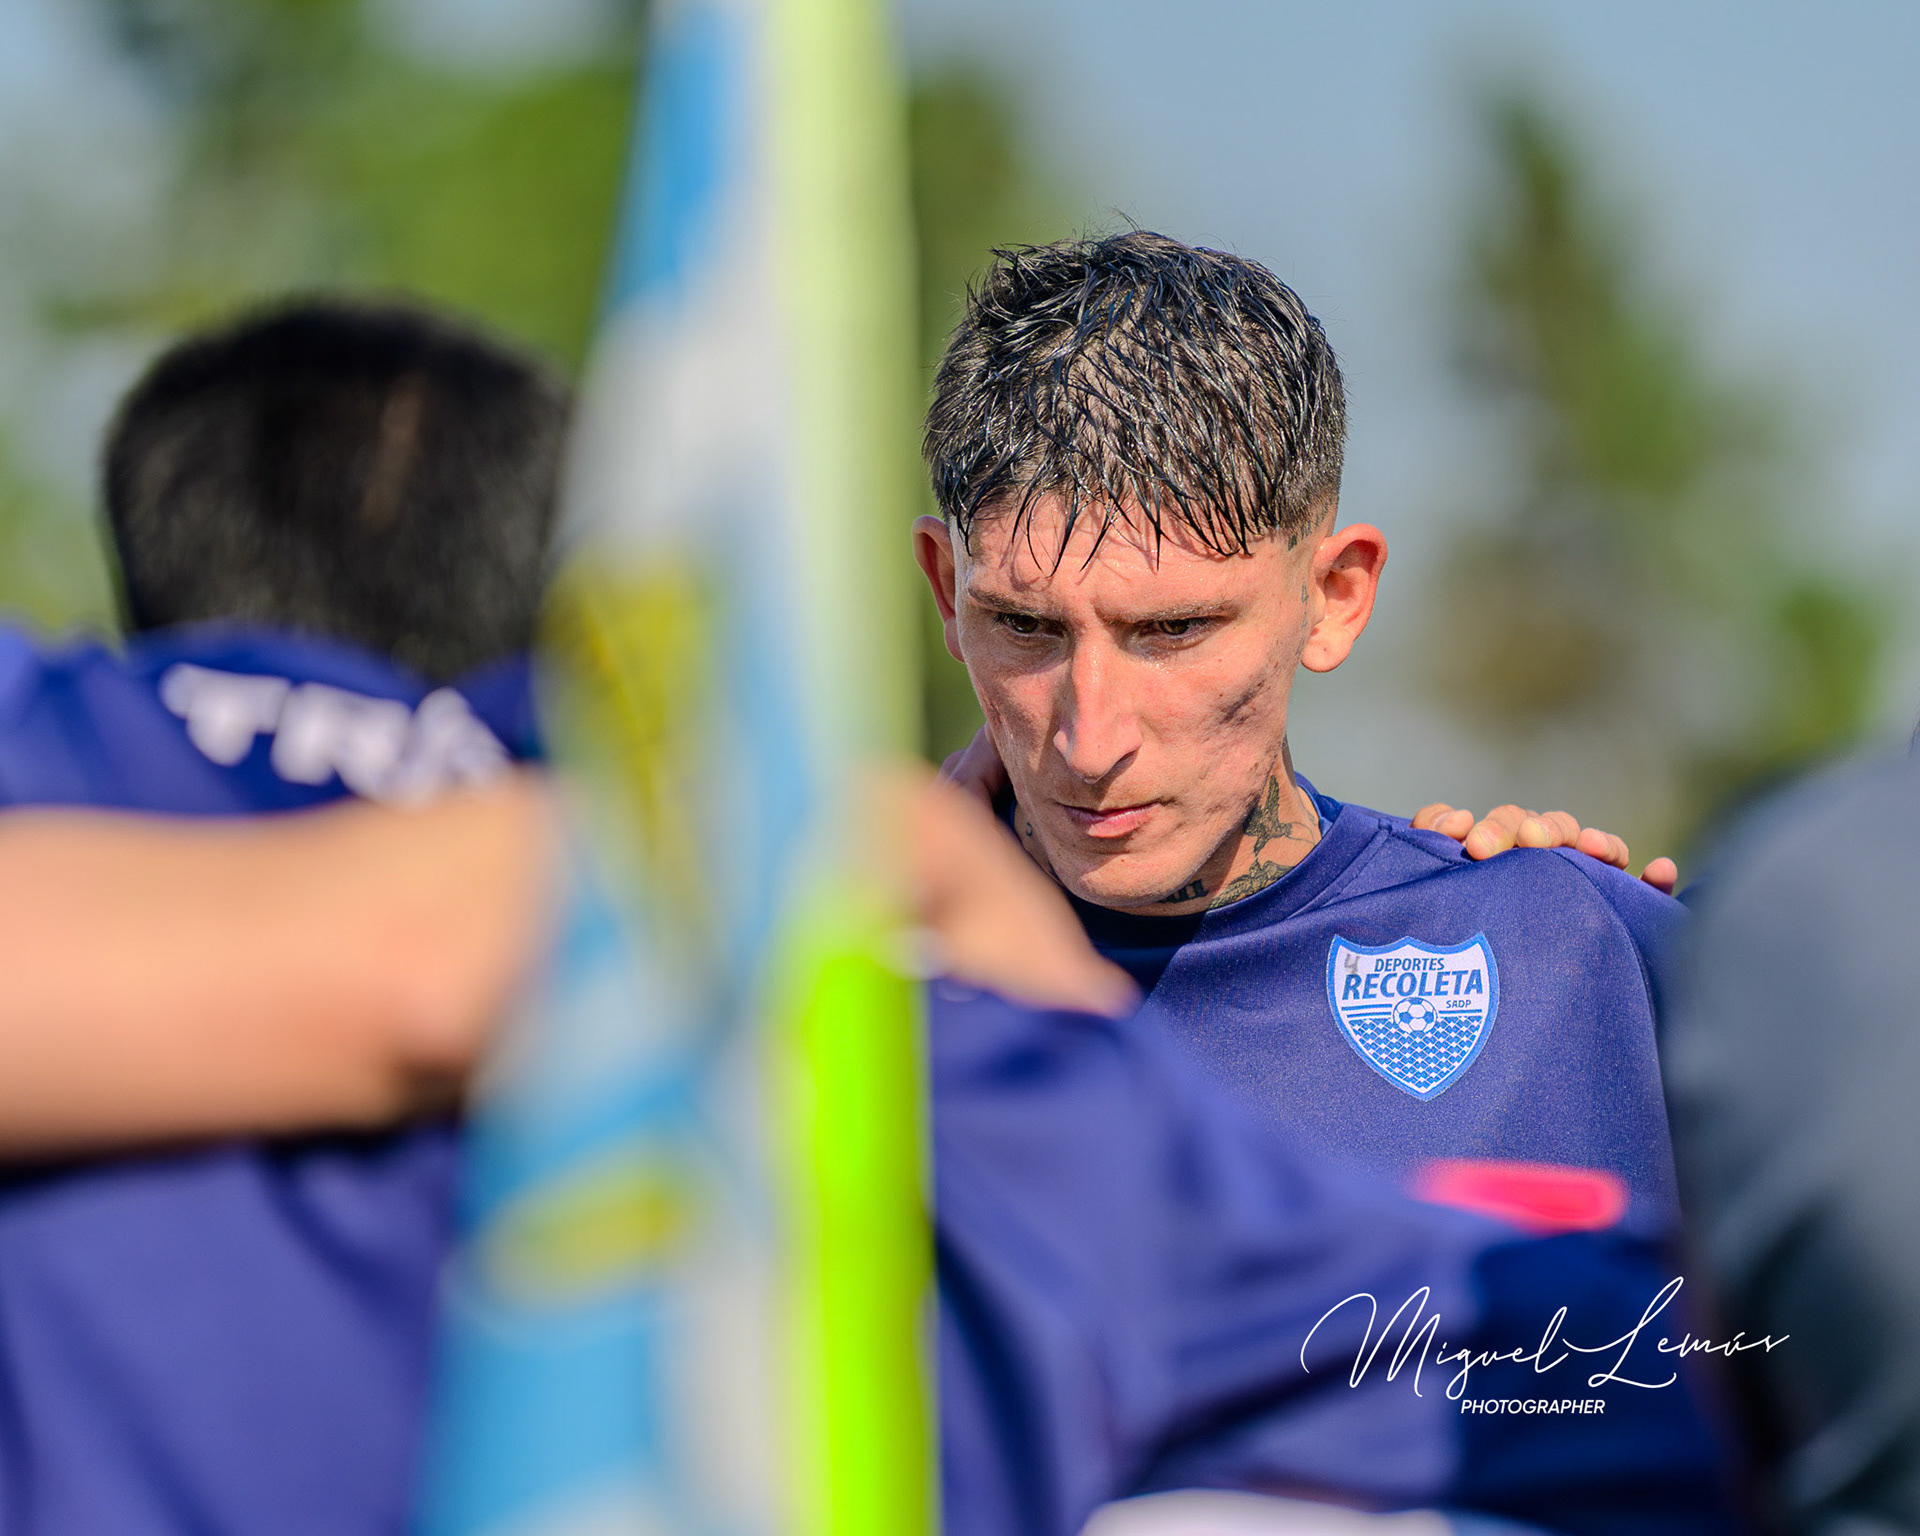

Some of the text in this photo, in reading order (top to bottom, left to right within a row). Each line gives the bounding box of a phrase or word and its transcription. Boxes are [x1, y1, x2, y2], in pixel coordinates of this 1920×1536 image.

[1373, 957, 1445, 972] DEPORTES
[1341, 968, 1484, 1001] RECOLETA
[1445, 999, 1472, 1009] SADP
